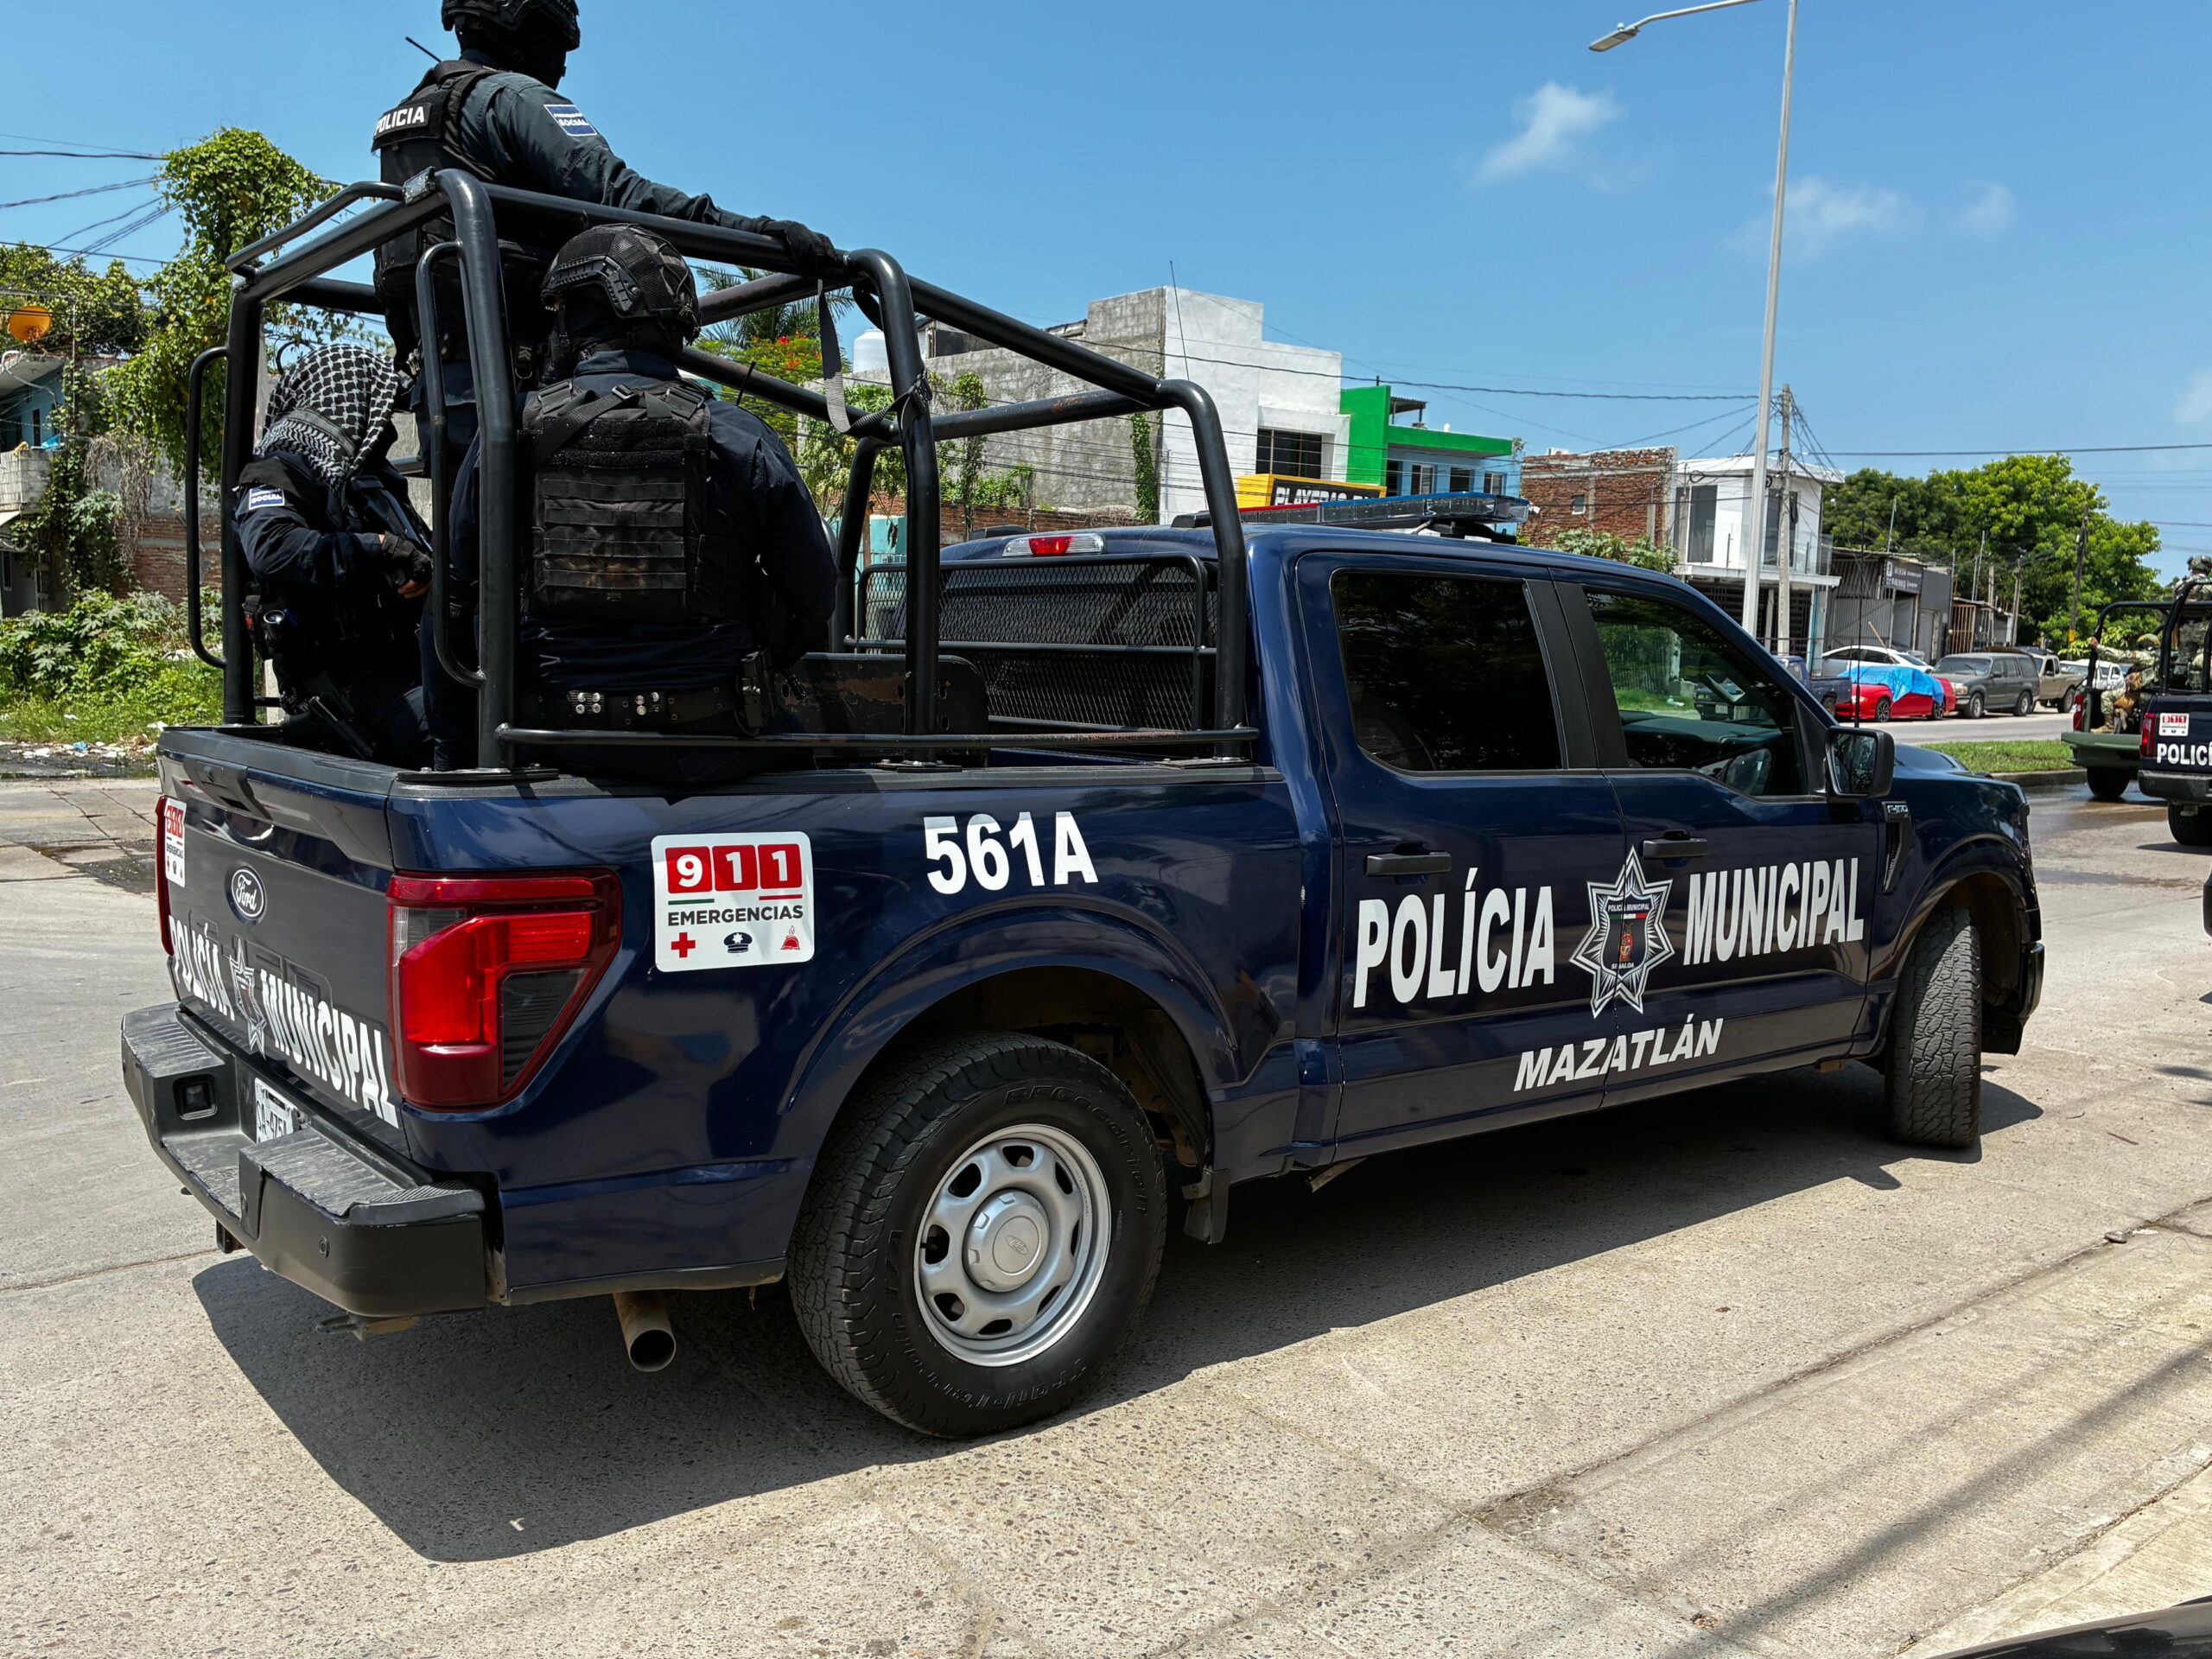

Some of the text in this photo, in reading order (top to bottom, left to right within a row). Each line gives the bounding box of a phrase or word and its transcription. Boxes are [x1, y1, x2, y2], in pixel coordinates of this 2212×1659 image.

[374, 106, 425, 137] POLICIA
[674, 849, 791, 888] 911
[923, 811, 1098, 894] 561A
[236, 874, 257, 912] Ford
[667, 905, 804, 927] EMERGENCIAS
[1353, 857, 1866, 1008] POLÍCIA MUNICIPAL
[261, 969, 399, 1128] MUNICIPAL
[1513, 1014, 1724, 1092] MAZATLÁN
